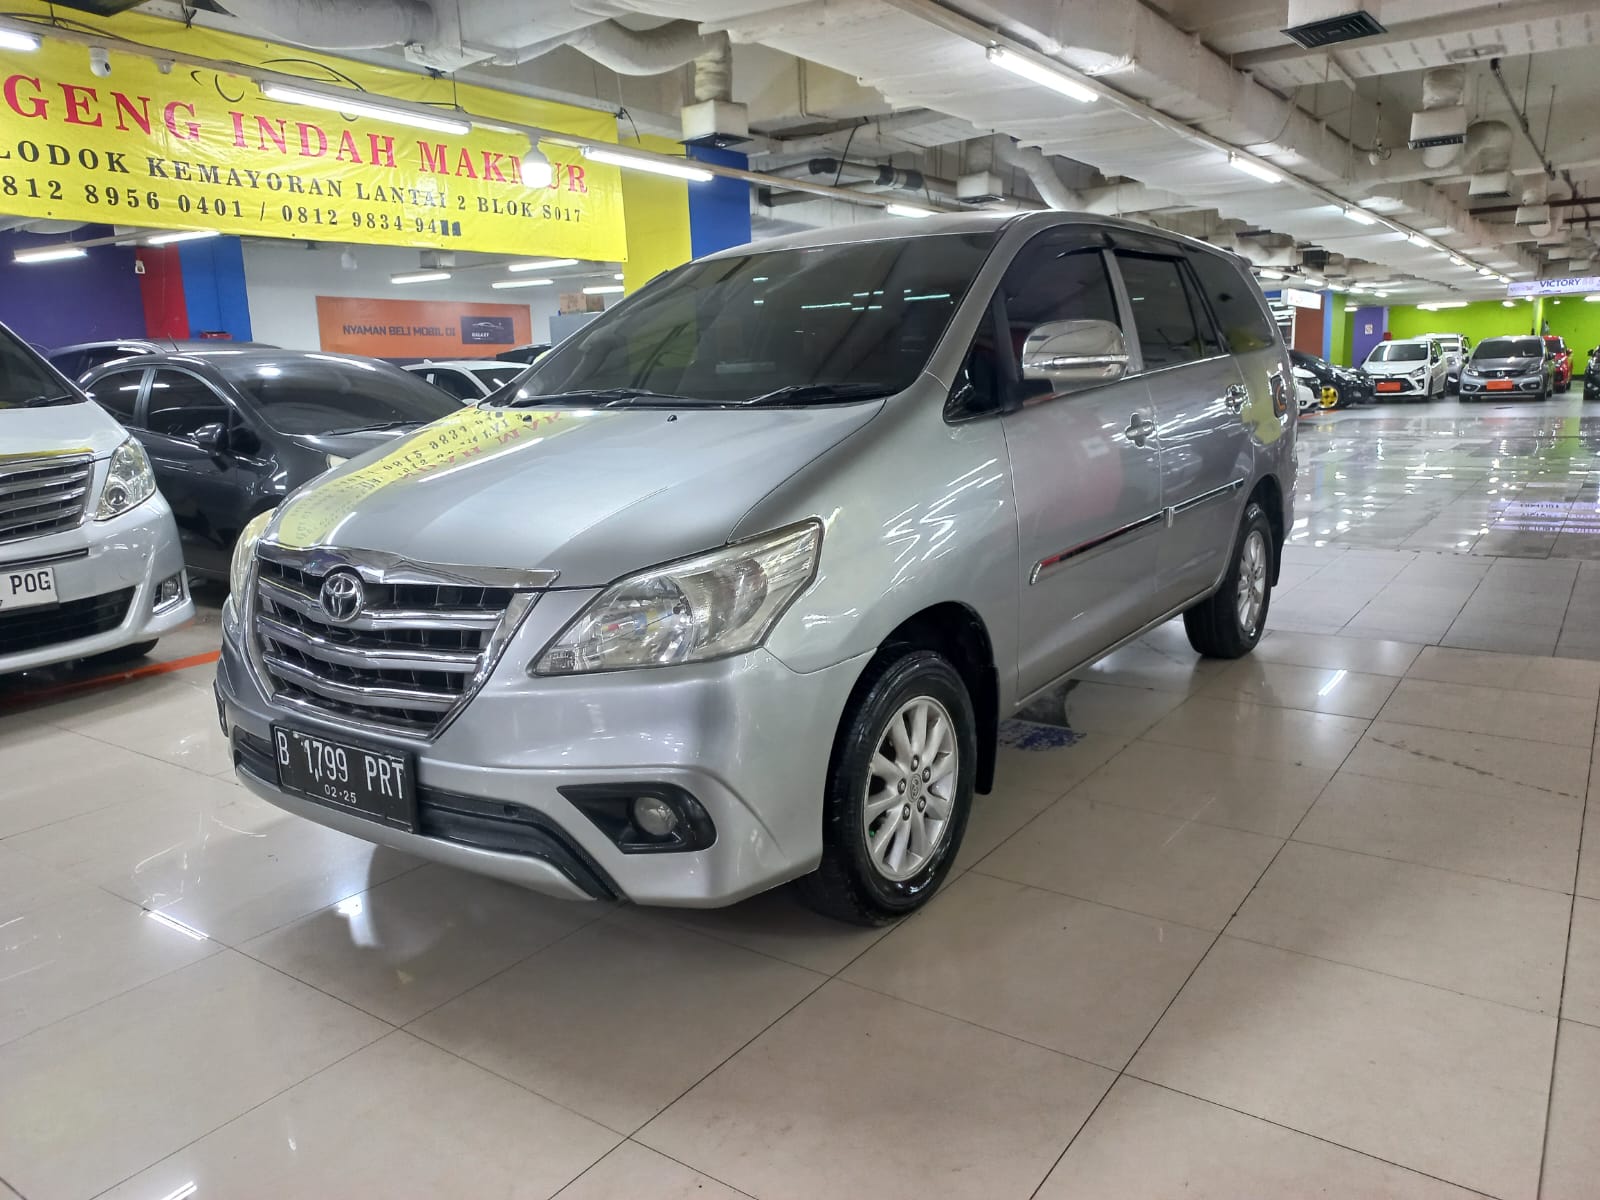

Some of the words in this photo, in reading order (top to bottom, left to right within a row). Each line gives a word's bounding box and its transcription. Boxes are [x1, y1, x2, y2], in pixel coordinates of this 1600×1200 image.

[3, 74, 202, 142] GENG
[228, 110, 397, 169] INDAH
[2, 175, 63, 200] 812
[85, 184, 160, 210] 8956
[178, 194, 244, 218] 0401
[282, 204, 338, 226] 0812
[352, 211, 403, 231] 9834
[415, 218, 462, 237] 94
[147, 156, 343, 198] KEMAYORAN
[356, 182, 447, 209] LANTAI
[458, 195, 466, 210] 2
[477, 196, 533, 218] BLOK
[543, 204, 581, 223] S017
[1539, 278, 1581, 288] VICTORY
[342, 325, 387, 336] NYAMAN
[389, 326, 411, 336] BELI
[413, 326, 443, 337] MOBIL
[9, 571, 52, 595] POG
[277, 731, 290, 765] B
[364, 754, 404, 800] PRT
